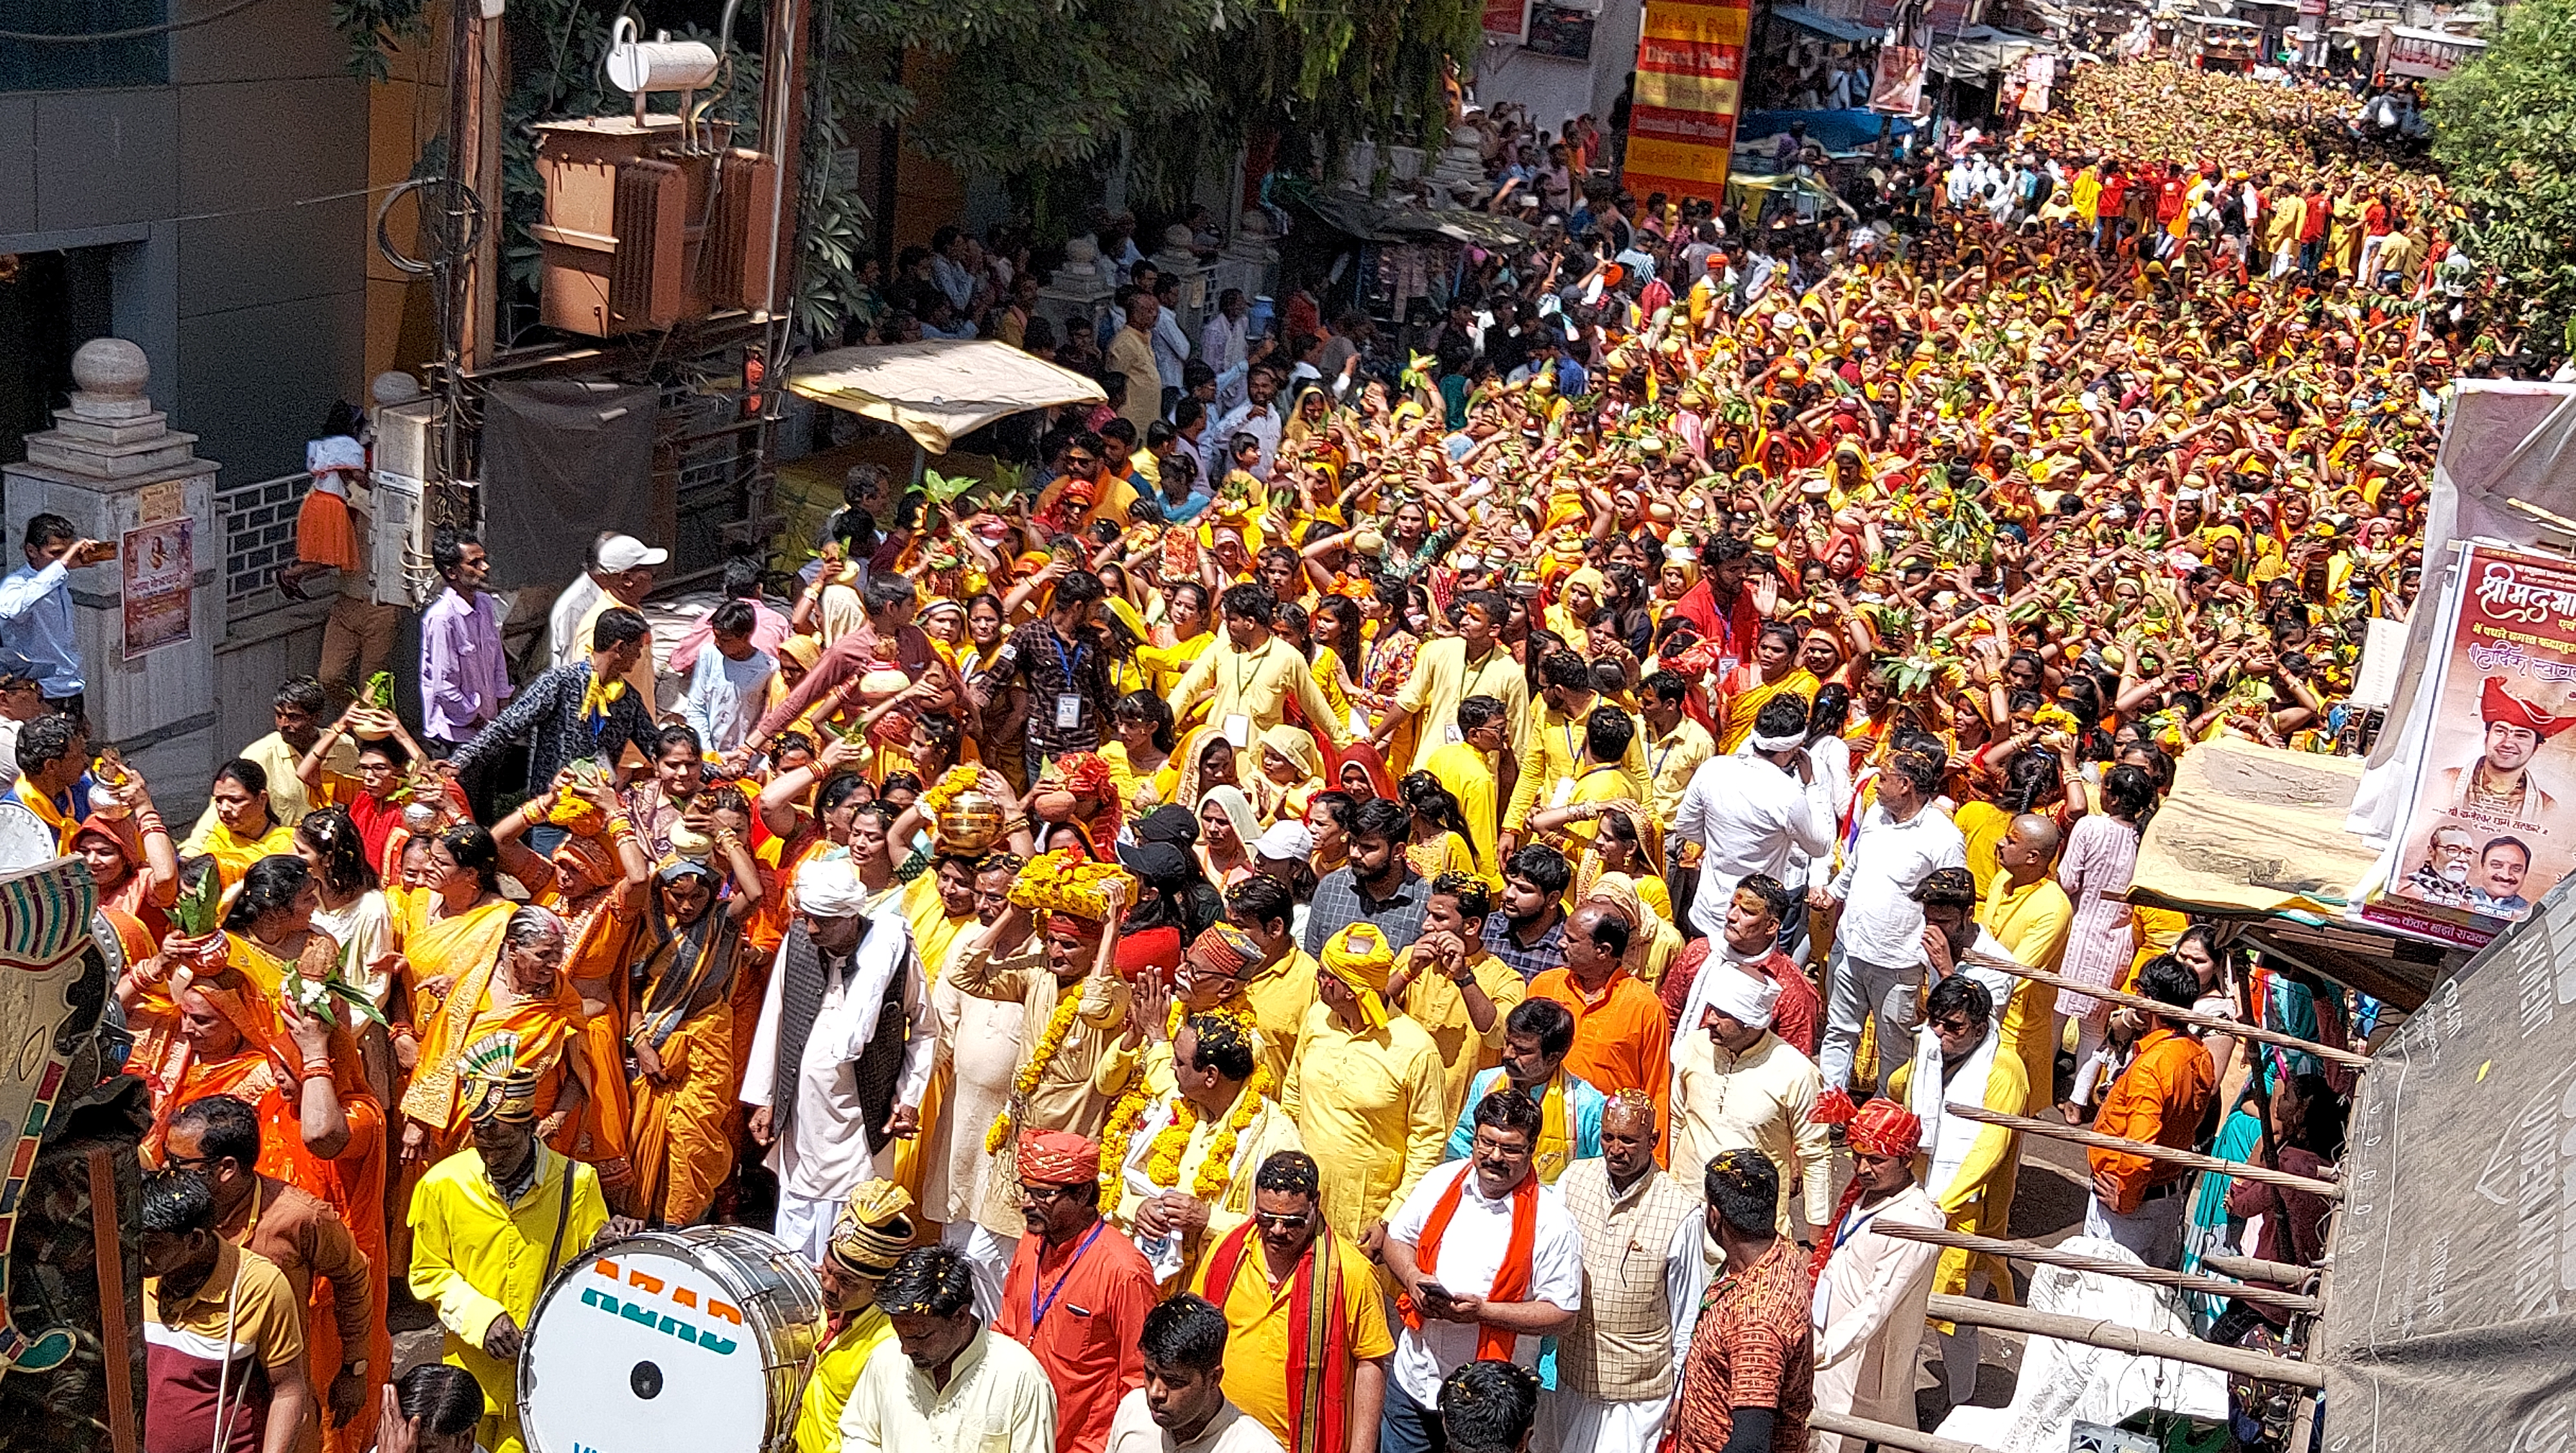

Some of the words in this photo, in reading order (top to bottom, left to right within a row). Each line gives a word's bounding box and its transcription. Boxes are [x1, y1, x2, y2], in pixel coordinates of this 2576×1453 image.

[1646, 46, 1694, 66] Direct
[1699, 50, 1736, 70] Post
[2511, 931, 2553, 1040] AYMENT
[581, 1258, 743, 1356] AZAD
